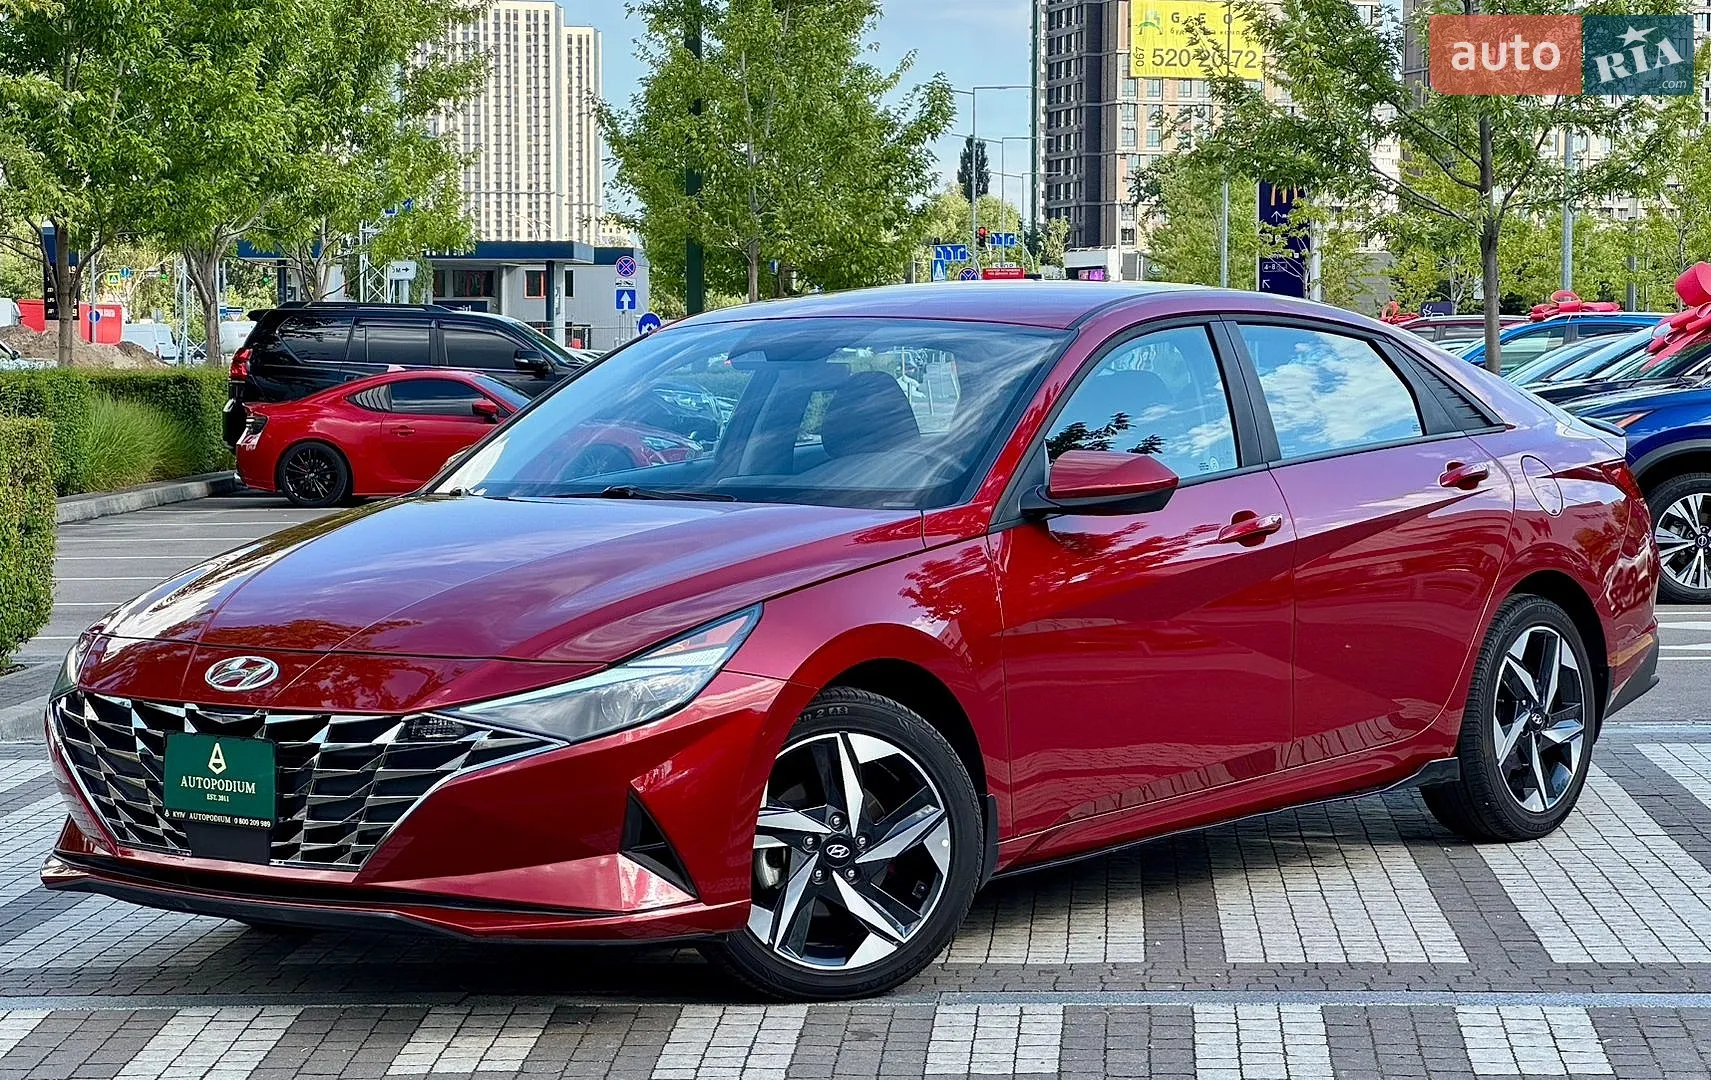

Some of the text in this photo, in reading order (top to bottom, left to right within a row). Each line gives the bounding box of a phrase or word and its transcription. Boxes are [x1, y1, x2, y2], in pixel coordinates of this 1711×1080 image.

[1135, 46, 1145, 67] 067
[1152, 48, 1191, 67] 520
[1231, 49, 1257, 69] 72
[180, 776, 256, 794] AUTOPODIUM
[172, 810, 186, 819] KYIV
[189, 812, 231, 824] AUTOPODIUM
[233, 817, 238, 825] 0
[238, 817, 249, 826] 800
[250, 818, 260, 827] 209
